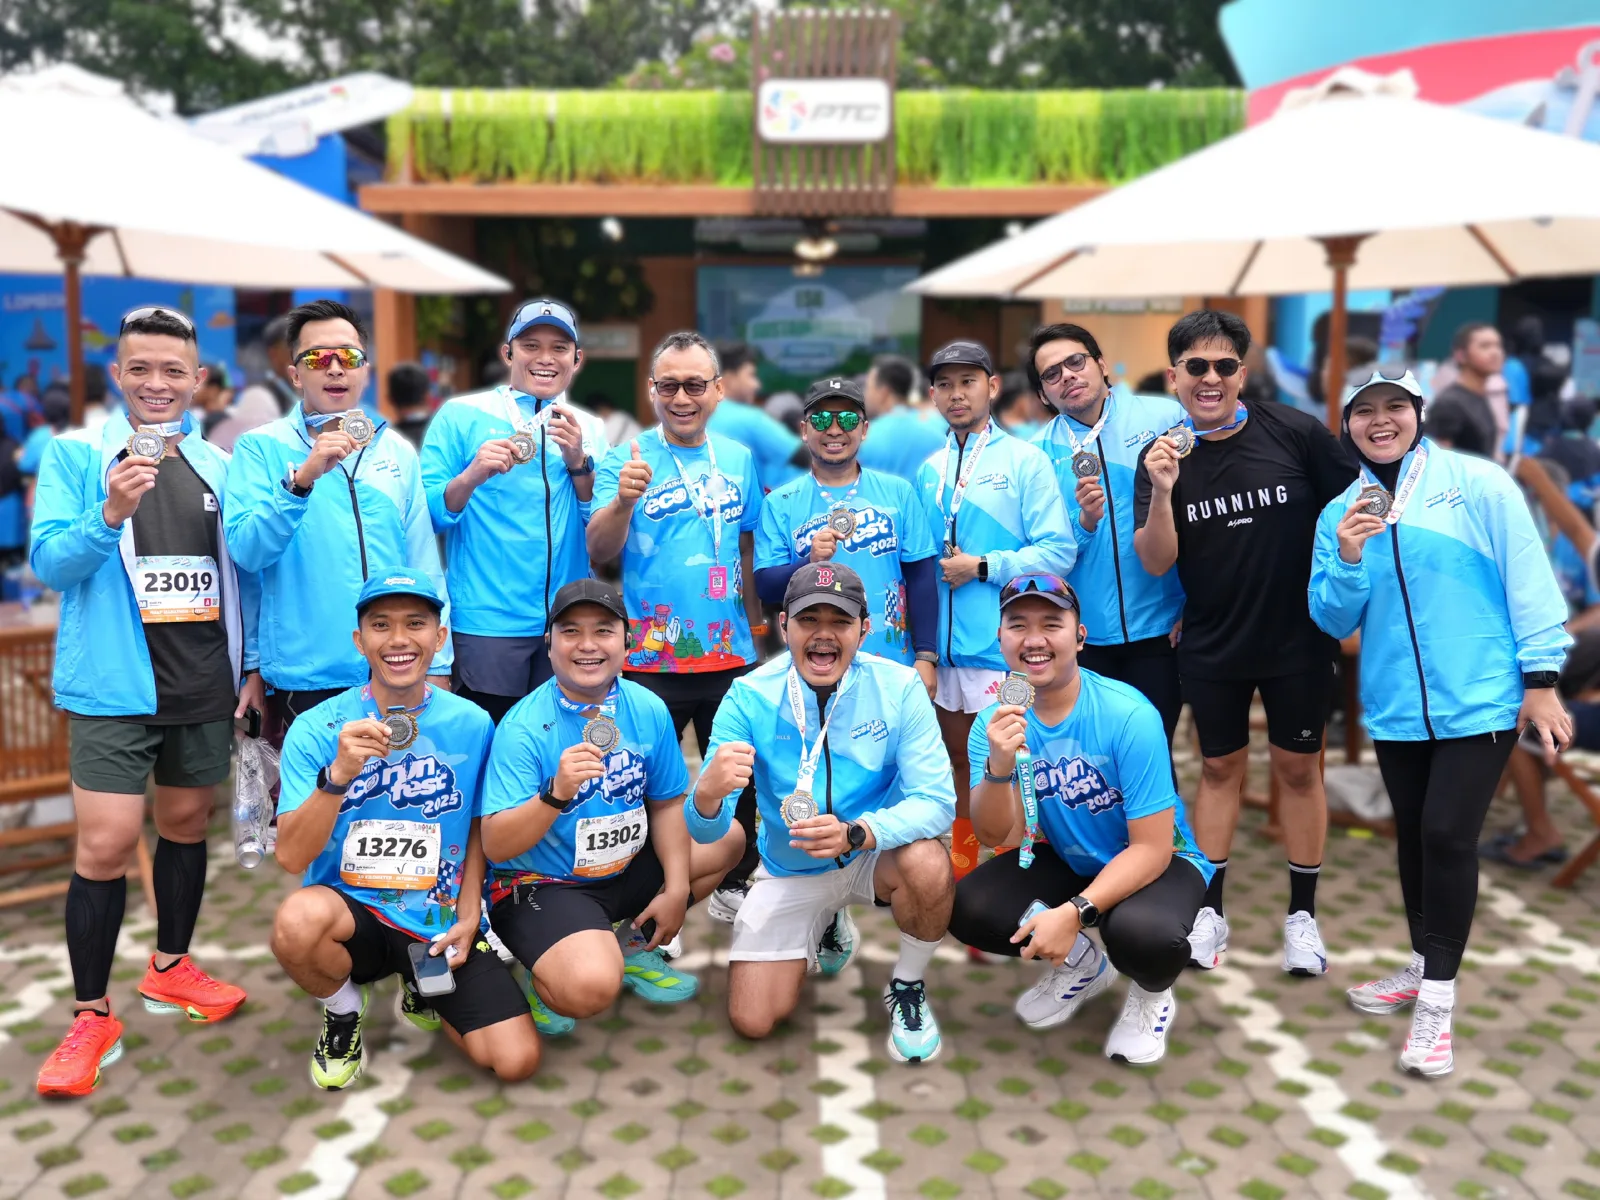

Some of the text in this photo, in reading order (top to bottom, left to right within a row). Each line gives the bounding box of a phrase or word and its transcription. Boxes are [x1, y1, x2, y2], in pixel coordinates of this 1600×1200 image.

[811, 103, 881, 122] PTC
[644, 487, 687, 514] eco
[1187, 485, 1288, 522] RUNNING
[871, 538, 897, 553] 2025
[144, 572, 212, 592] 23019
[815, 567, 834, 587] B
[382, 757, 436, 787] run
[391, 770, 448, 802] fest
[1022, 776, 1032, 796] FUN
[1059, 768, 1102, 801] fest
[424, 792, 460, 814] 2025
[1025, 796, 1036, 817] RUN
[1086, 789, 1118, 810] 2025
[356, 837, 427, 859] 13276
[586, 823, 641, 851] 13302
